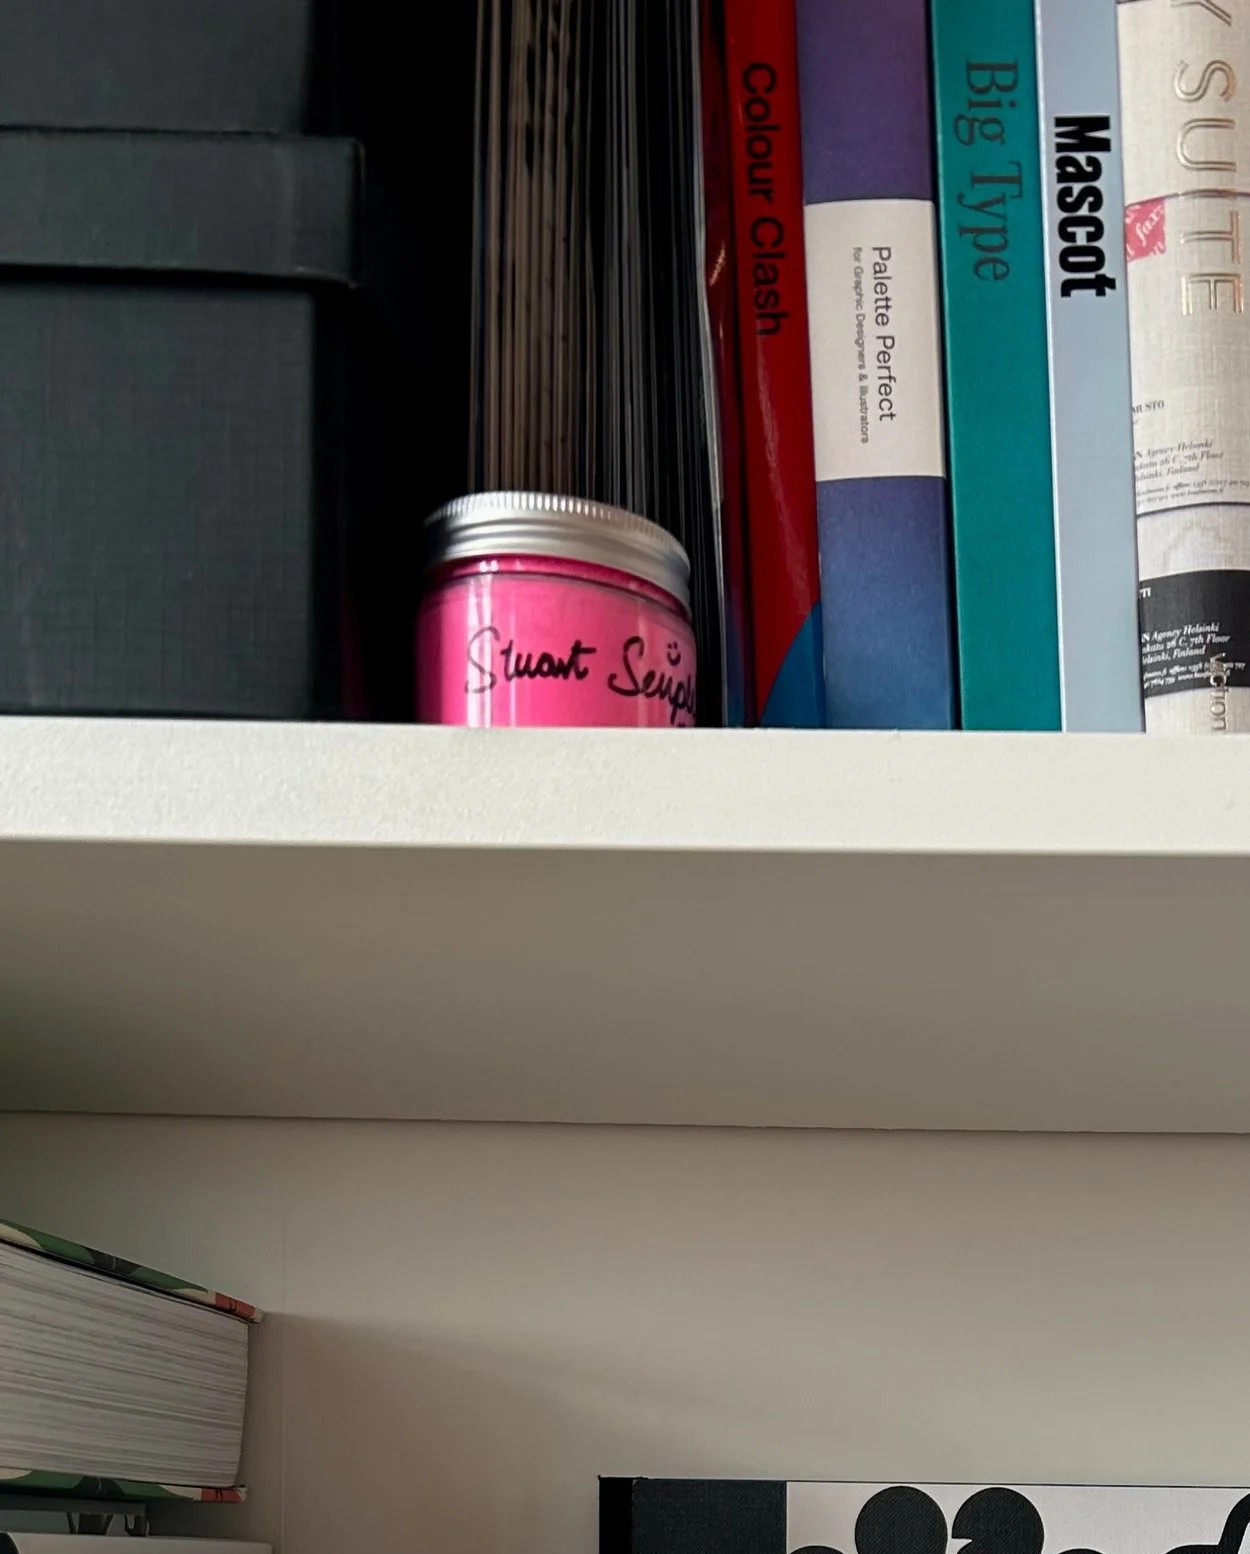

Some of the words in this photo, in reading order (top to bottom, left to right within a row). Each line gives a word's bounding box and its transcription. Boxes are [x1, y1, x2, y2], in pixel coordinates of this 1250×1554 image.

[742, 62, 781, 204] Colour
[953, 58, 1019, 146] Big
[956, 160, 1023, 281] Type
[1054, 115, 1116, 298] Mascot
[1172, 59, 1244, 316] SUITE
[750, 216, 789, 336] Clash
[852, 247, 864, 263] for
[853, 266, 866, 310] Graphic
[871, 246, 893, 326] Palette
[855, 313, 867, 370] Designers
[876, 335, 897, 421] Perfect
[859, 385, 871, 444] Illustrators
[466, 626, 597, 694] Stuart
